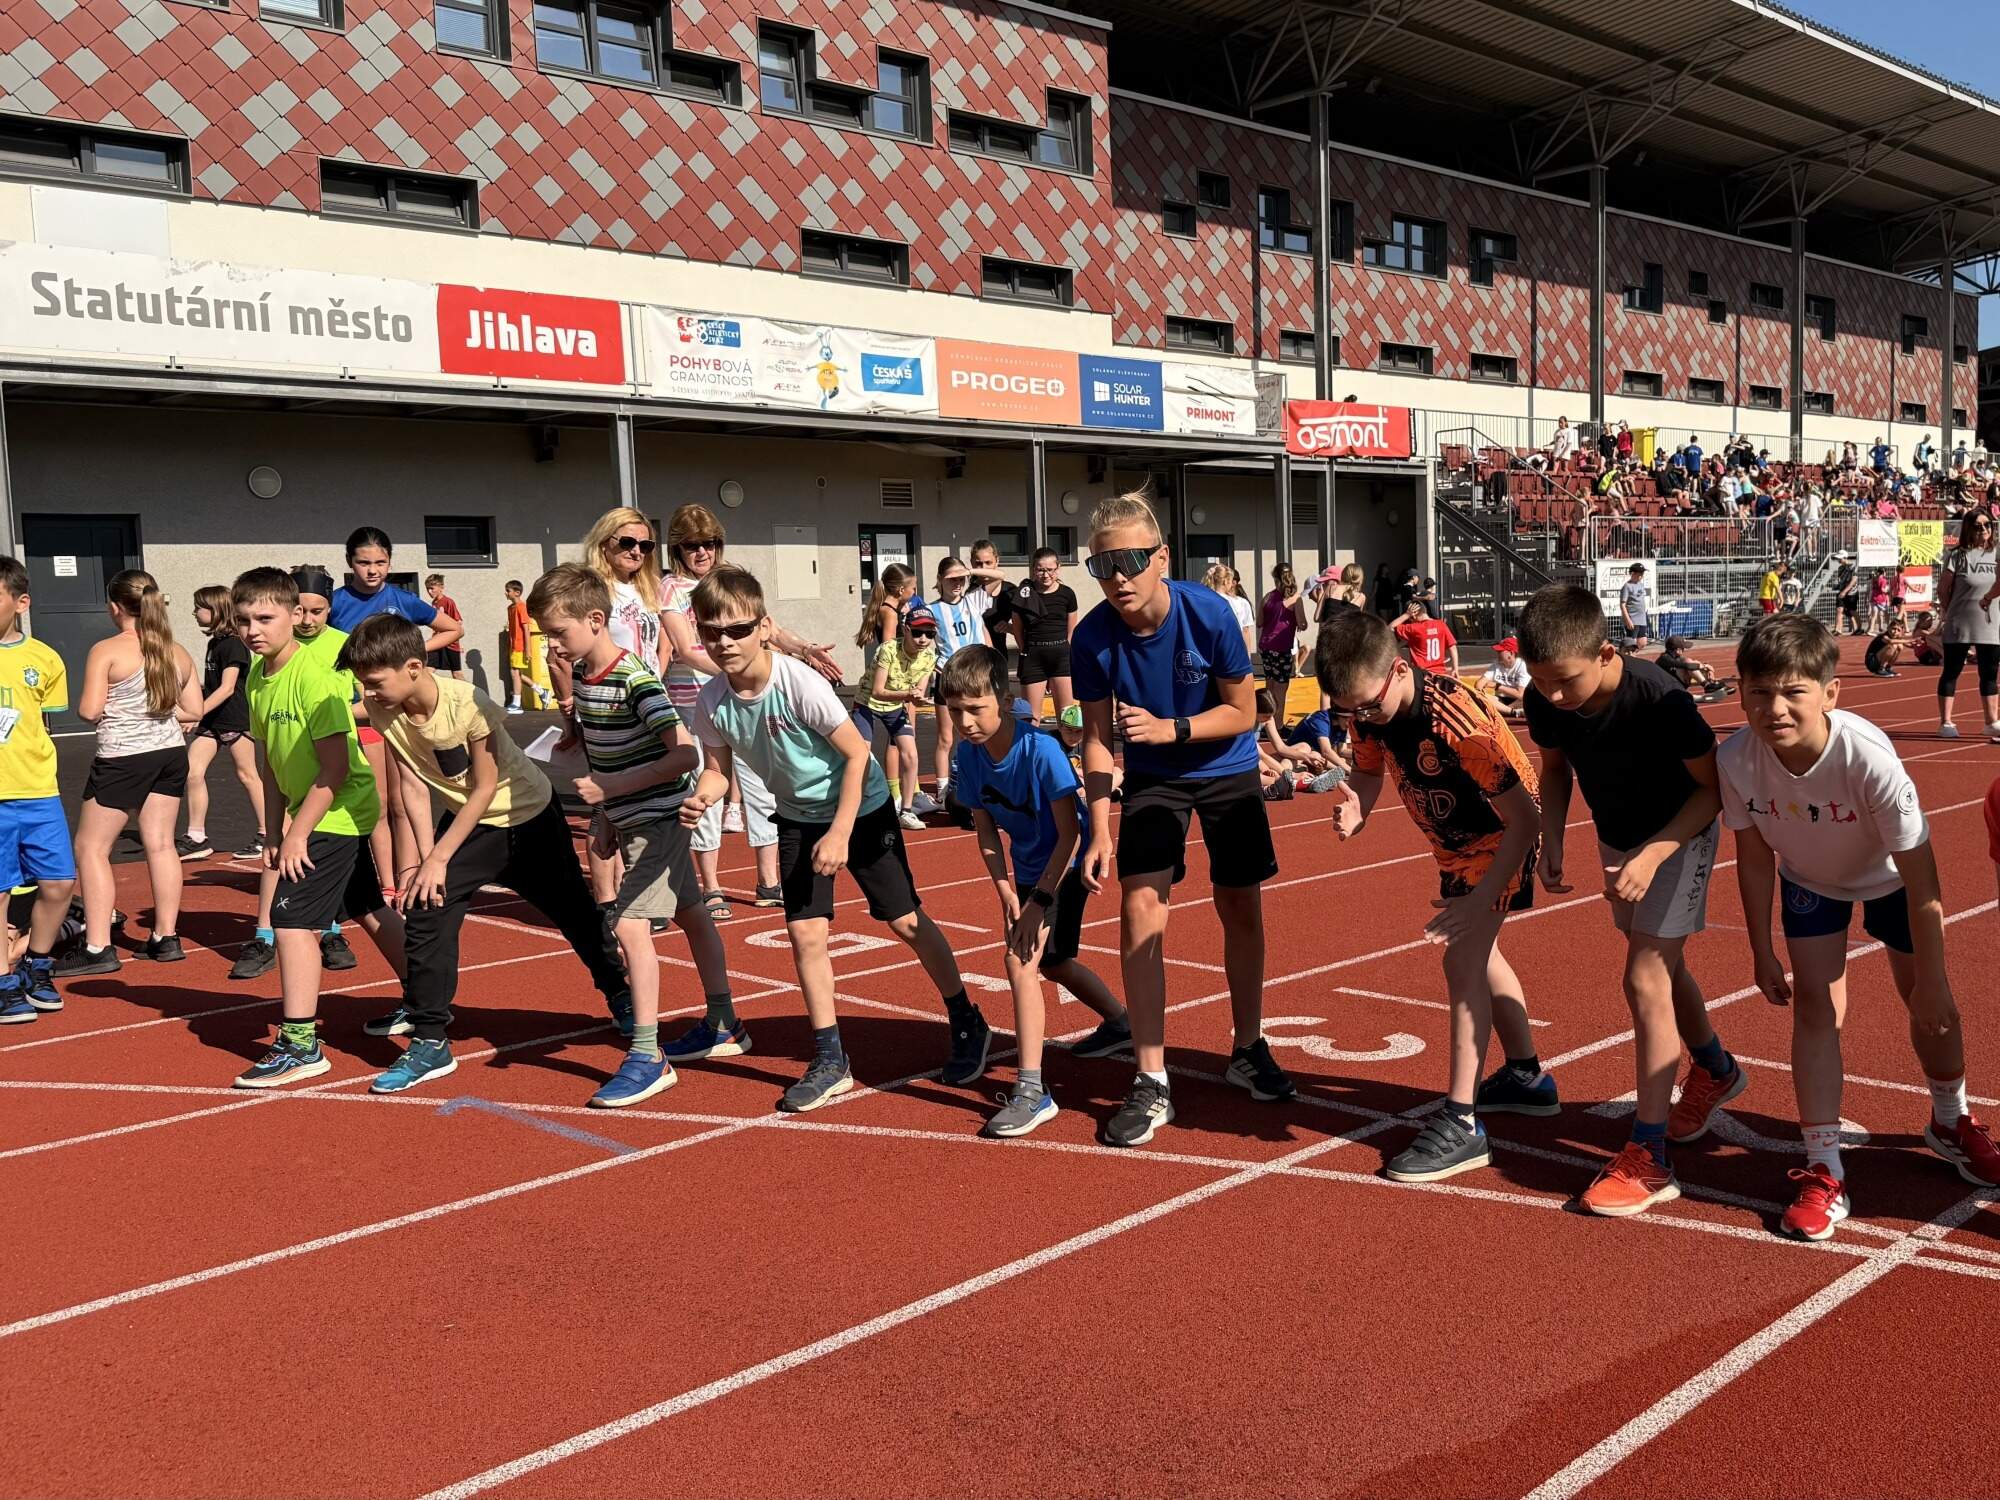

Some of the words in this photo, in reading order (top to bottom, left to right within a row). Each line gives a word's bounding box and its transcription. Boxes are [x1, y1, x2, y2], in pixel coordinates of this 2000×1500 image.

[31, 272, 271, 333] Statutární
[289, 298, 413, 343] město
[465, 309, 598, 358] Jihlava
[670, 355, 753, 374] POHYBOVÁ
[670, 370, 753, 387] GRAMOTNOST
[951, 370, 1065, 397] PROGEO
[1113, 383, 1142, 395] SOLAR
[1113, 394, 1151, 406] HUNTER
[1186, 406, 1236, 422] PRIMONT
[1968, 562, 1997, 574] VAN
[952, 620, 968, 637] 10
[1426, 637, 1440, 661] 10
